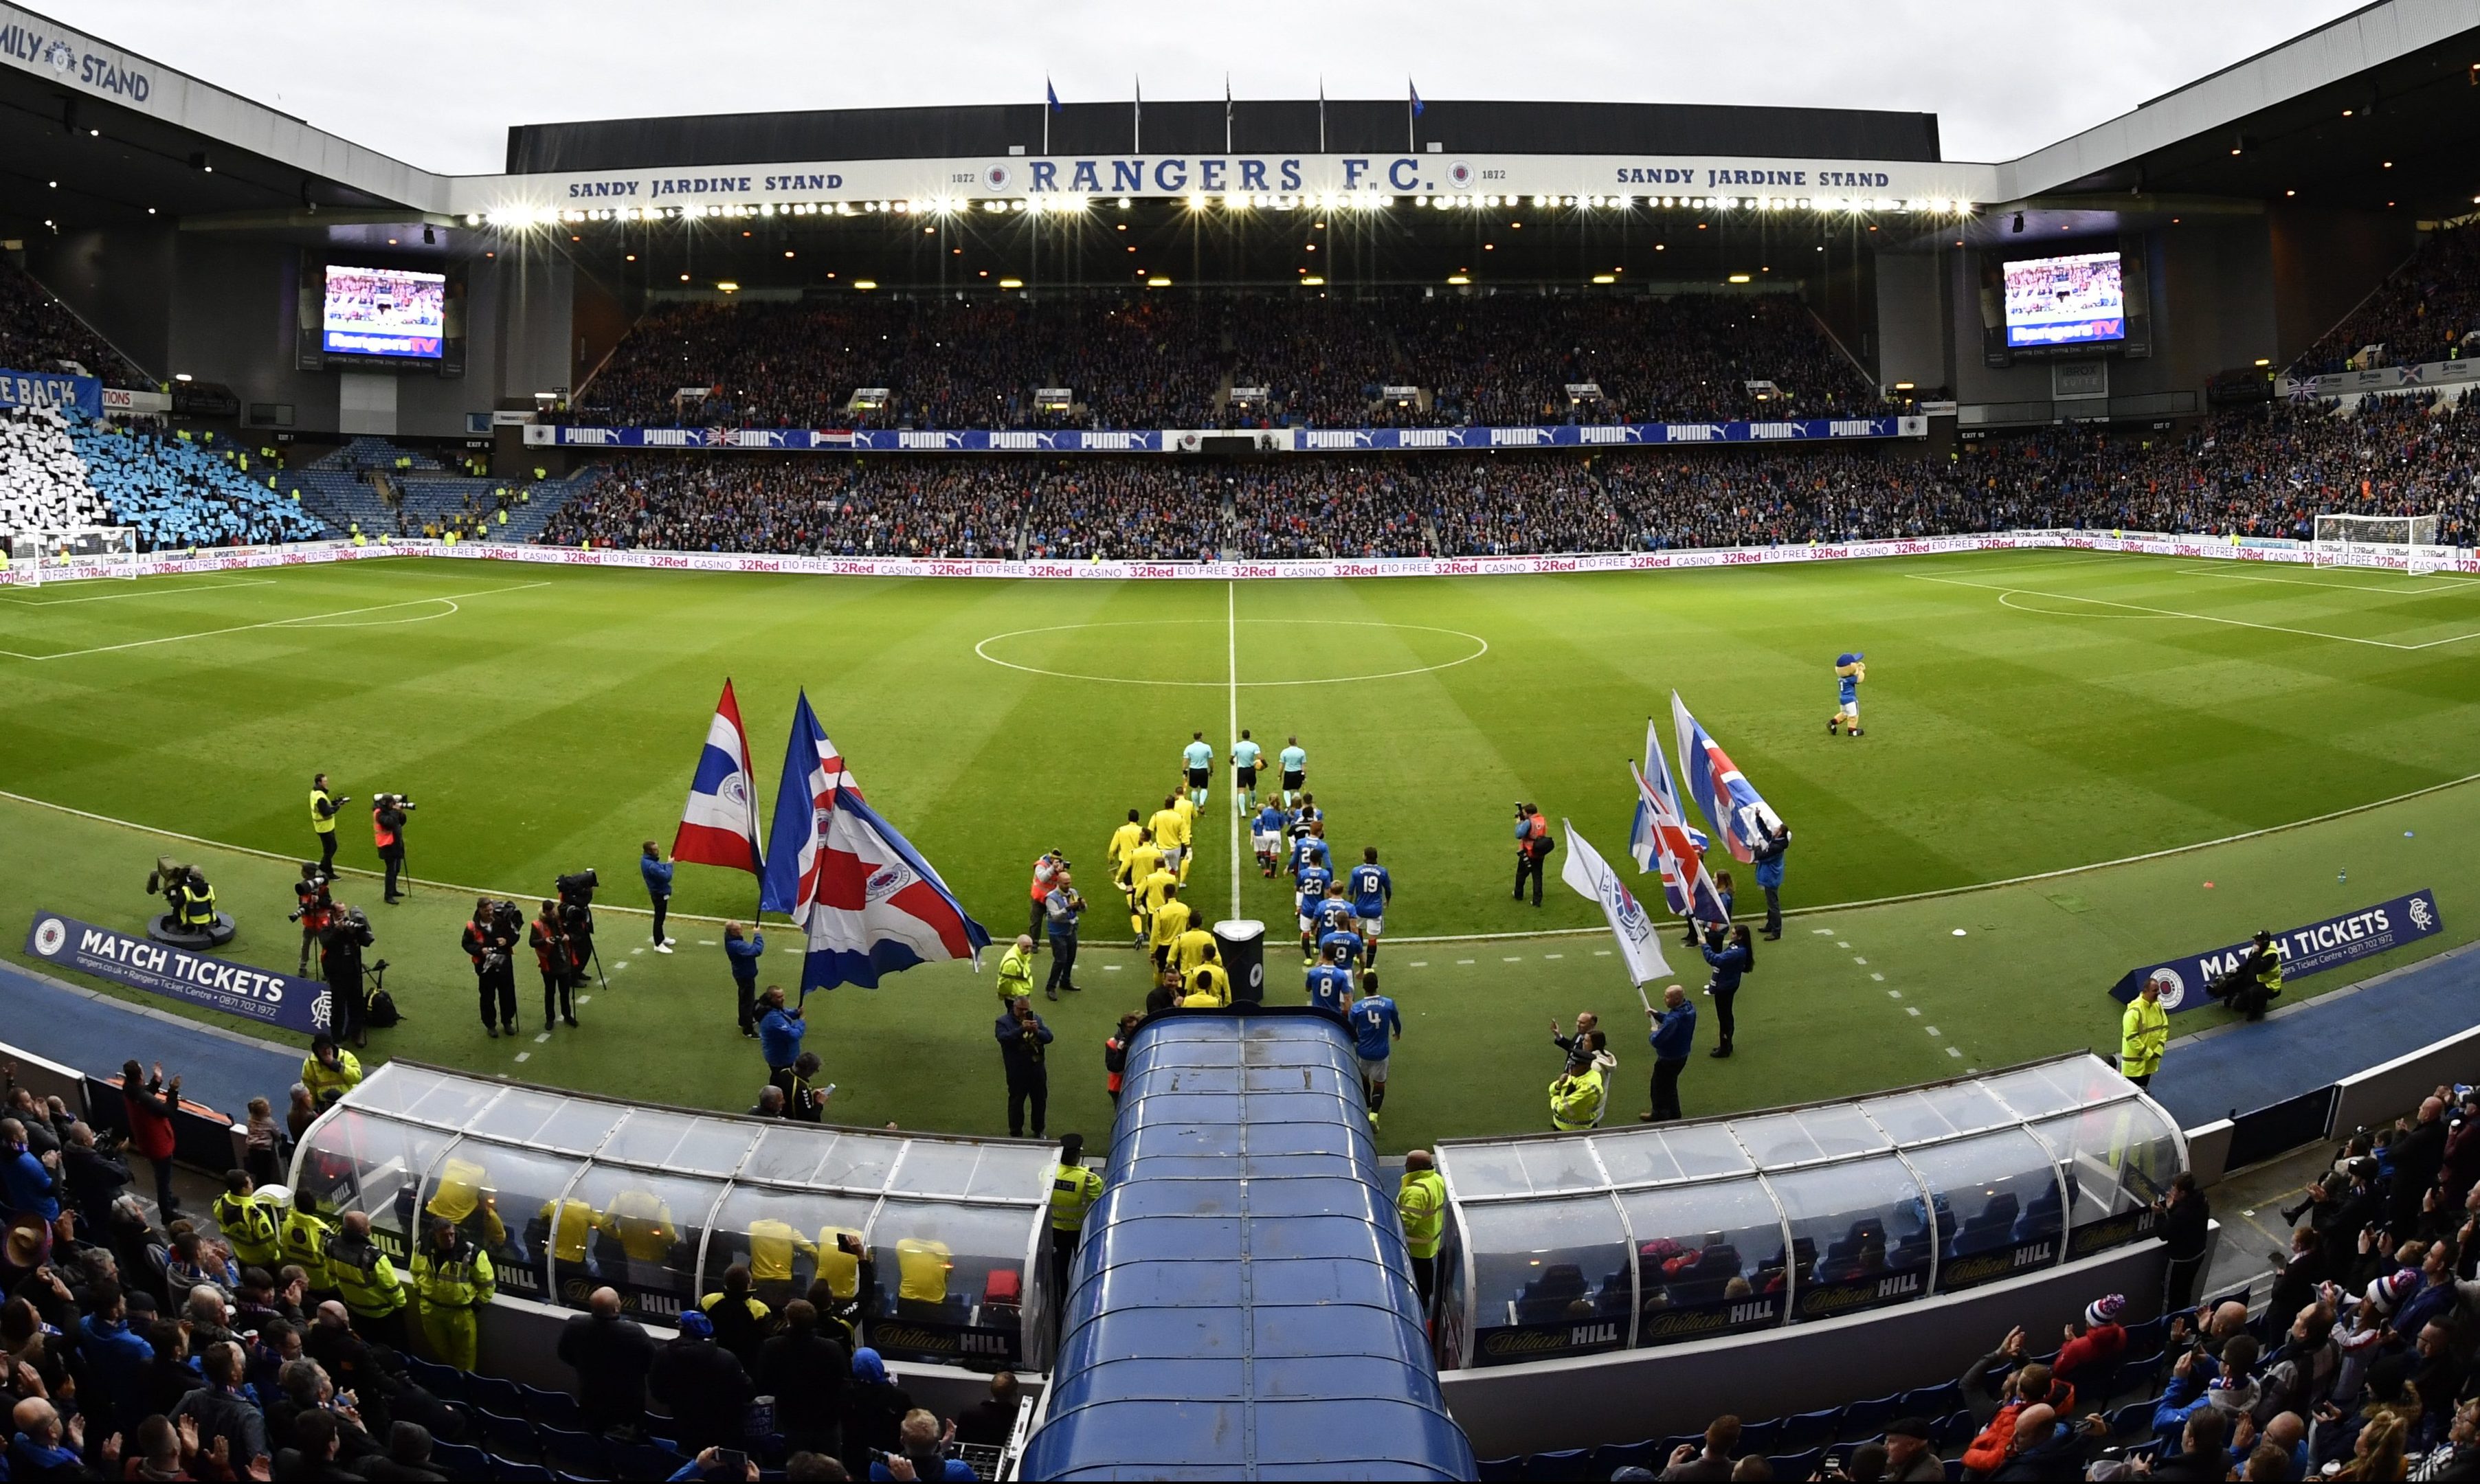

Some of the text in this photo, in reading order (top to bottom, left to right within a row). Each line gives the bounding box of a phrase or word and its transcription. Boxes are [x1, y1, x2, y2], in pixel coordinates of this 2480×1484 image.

[80, 54, 149, 102] STAND
[569, 174, 843, 199] SANDY JARDINE STAND
[952, 172, 976, 184] 1872
[1029, 159, 1302, 193] RANGERS
[1482, 169, 1506, 180] 1872
[1617, 168, 1890, 188] SANDY JARDINE STAND
[17, 378, 76, 410] BACK
[565, 428, 1130, 449] PUMA PUMA PUMA PUMA PUMA
[1307, 420, 1870, 449] PUMA PUMA PUMA PUMA PUMA PUMA PUMA
[53, 569, 75, 579] FREE
[77, 567, 111, 578] 32Red
[152, 561, 183, 574] 32Red
[184, 560, 198, 571] £10
[199, 559, 218, 570] FREE
[220, 559, 248, 570] 32Red
[252, 556, 277, 567] CASINO
[281, 553, 306, 564] 32Red
[308, 552, 319, 561] £10
[319, 550, 333, 560] FREE
[335, 548, 357, 561] 32Red
[392, 547, 429, 556] 32Red
[433, 548, 448, 556] £10
[451, 548, 476, 556] FREE
[480, 549, 519, 561] 32Red
[524, 552, 558, 563] CASINO
[563, 552, 601, 565] 32Red
[603, 554, 619, 563] £10
[621, 555, 647, 565] FREE
[649, 556, 688, 568] 32Red
[694, 560, 733, 570] CASINO
[738, 560, 779, 572] 32Red
[783, 561, 799, 570] £10
[803, 561, 829, 571] FREE
[832, 563, 874, 574] 32Red
[881, 565, 921, 576] CASINO
[929, 565, 972, 576] 32Red
[976, 565, 994, 574] £10
[996, 565, 1025, 574] FREE
[1028, 566, 1073, 577] 32Red
[1080, 568, 1122, 578] CASINO
[1130, 566, 1174, 577] 32Red
[1177, 566, 1196, 575] £10
[1199, 566, 1228, 575] FREE
[1231, 566, 1276, 577] 32Red
[1283, 567, 1326, 577] CASINO
[1333, 565, 1378, 576] 32Red
[1381, 564, 1399, 574] £10
[1403, 563, 1431, 573] FREE
[1433, 563, 1478, 574] 32Red
[1484, 563, 1526, 574] CASINO
[1533, 560, 1576, 572] 32Red
[1578, 559, 1596, 568] £10
[1599, 557, 1627, 567] FREE
[1629, 556, 1671, 568] 32Red
[1677, 556, 1716, 567] CASINO
[1721, 552, 1761, 564] 32Red
[1764, 550, 1780, 560] £10
[1783, 549, 1808, 559] FREE
[1810, 548, 1848, 559] 32Red
[1853, 547, 1889, 558] CASINO
[1895, 543, 1930, 554] 32Red
[1932, 541, 1946, 550] £10
[1950, 540, 1974, 550] FREE
[1977, 539, 2015, 550] 32Red
[2022, 540, 2056, 548] CASINO
[2062, 539, 2093, 549] 32Red
[2105, 540, 2119, 550] FREE
[2121, 540, 2144, 552] 32Red
[2147, 545, 2170, 555] CASINO
[2174, 544, 2201, 556] 32Red
[2202, 546, 2214, 556] £10
[2216, 547, 2234, 558] FREE
[2235, 548, 2264, 561] 32Red
[2268, 552, 2299, 564] CASINO
[2351, 554, 2372, 566] FREE
[2374, 556, 2408, 568] 32Red
[2413, 561, 2448, 572] CASINO
[1304, 878, 1323, 895] 23
[1363, 875, 1378, 893] 19
[2293, 908, 2390, 955] TICKETS
[80, 928, 169, 973] MATCH
[172, 954, 285, 1002] TICKETS
[1334, 946, 1348, 963] 9
[2280, 963, 2296, 977] gers
[2296, 958, 2319, 973] Ticket
[2319, 949, 2343, 967] Centre
[2347, 941, 2364, 955] 0871
[2365, 937, 2378, 949] 702
[2380, 933, 2393, 946] 1972
[76, 956, 123, 976] rangers.co.uk
[129, 970, 159, 987] Rangers
[161, 976, 184, 994] Ticket
[186, 983, 212, 1000] Centre
[219, 995, 239, 1008] 0871
[240, 999, 256, 1012] 702
[258, 1004, 277, 1017] 1972
[1320, 978, 1332, 997] 8
[1367, 1009, 1381, 1029] 4
[332, 1182, 351, 1206] HILL
[2137, 1212, 2155, 1232] HI
[370, 1233, 405, 1258] HILL
[2013, 1241, 2051, 1267] HILL
[498, 1264, 538, 1290] HILL
[1877, 1272, 1918, 1298] HILL
[640, 1293, 680, 1316] HILL
[1730, 1300, 1774, 1324] HILL
[873, 1323, 1009, 1355] William HILL
[1570, 1323, 1618, 1345] HILL
